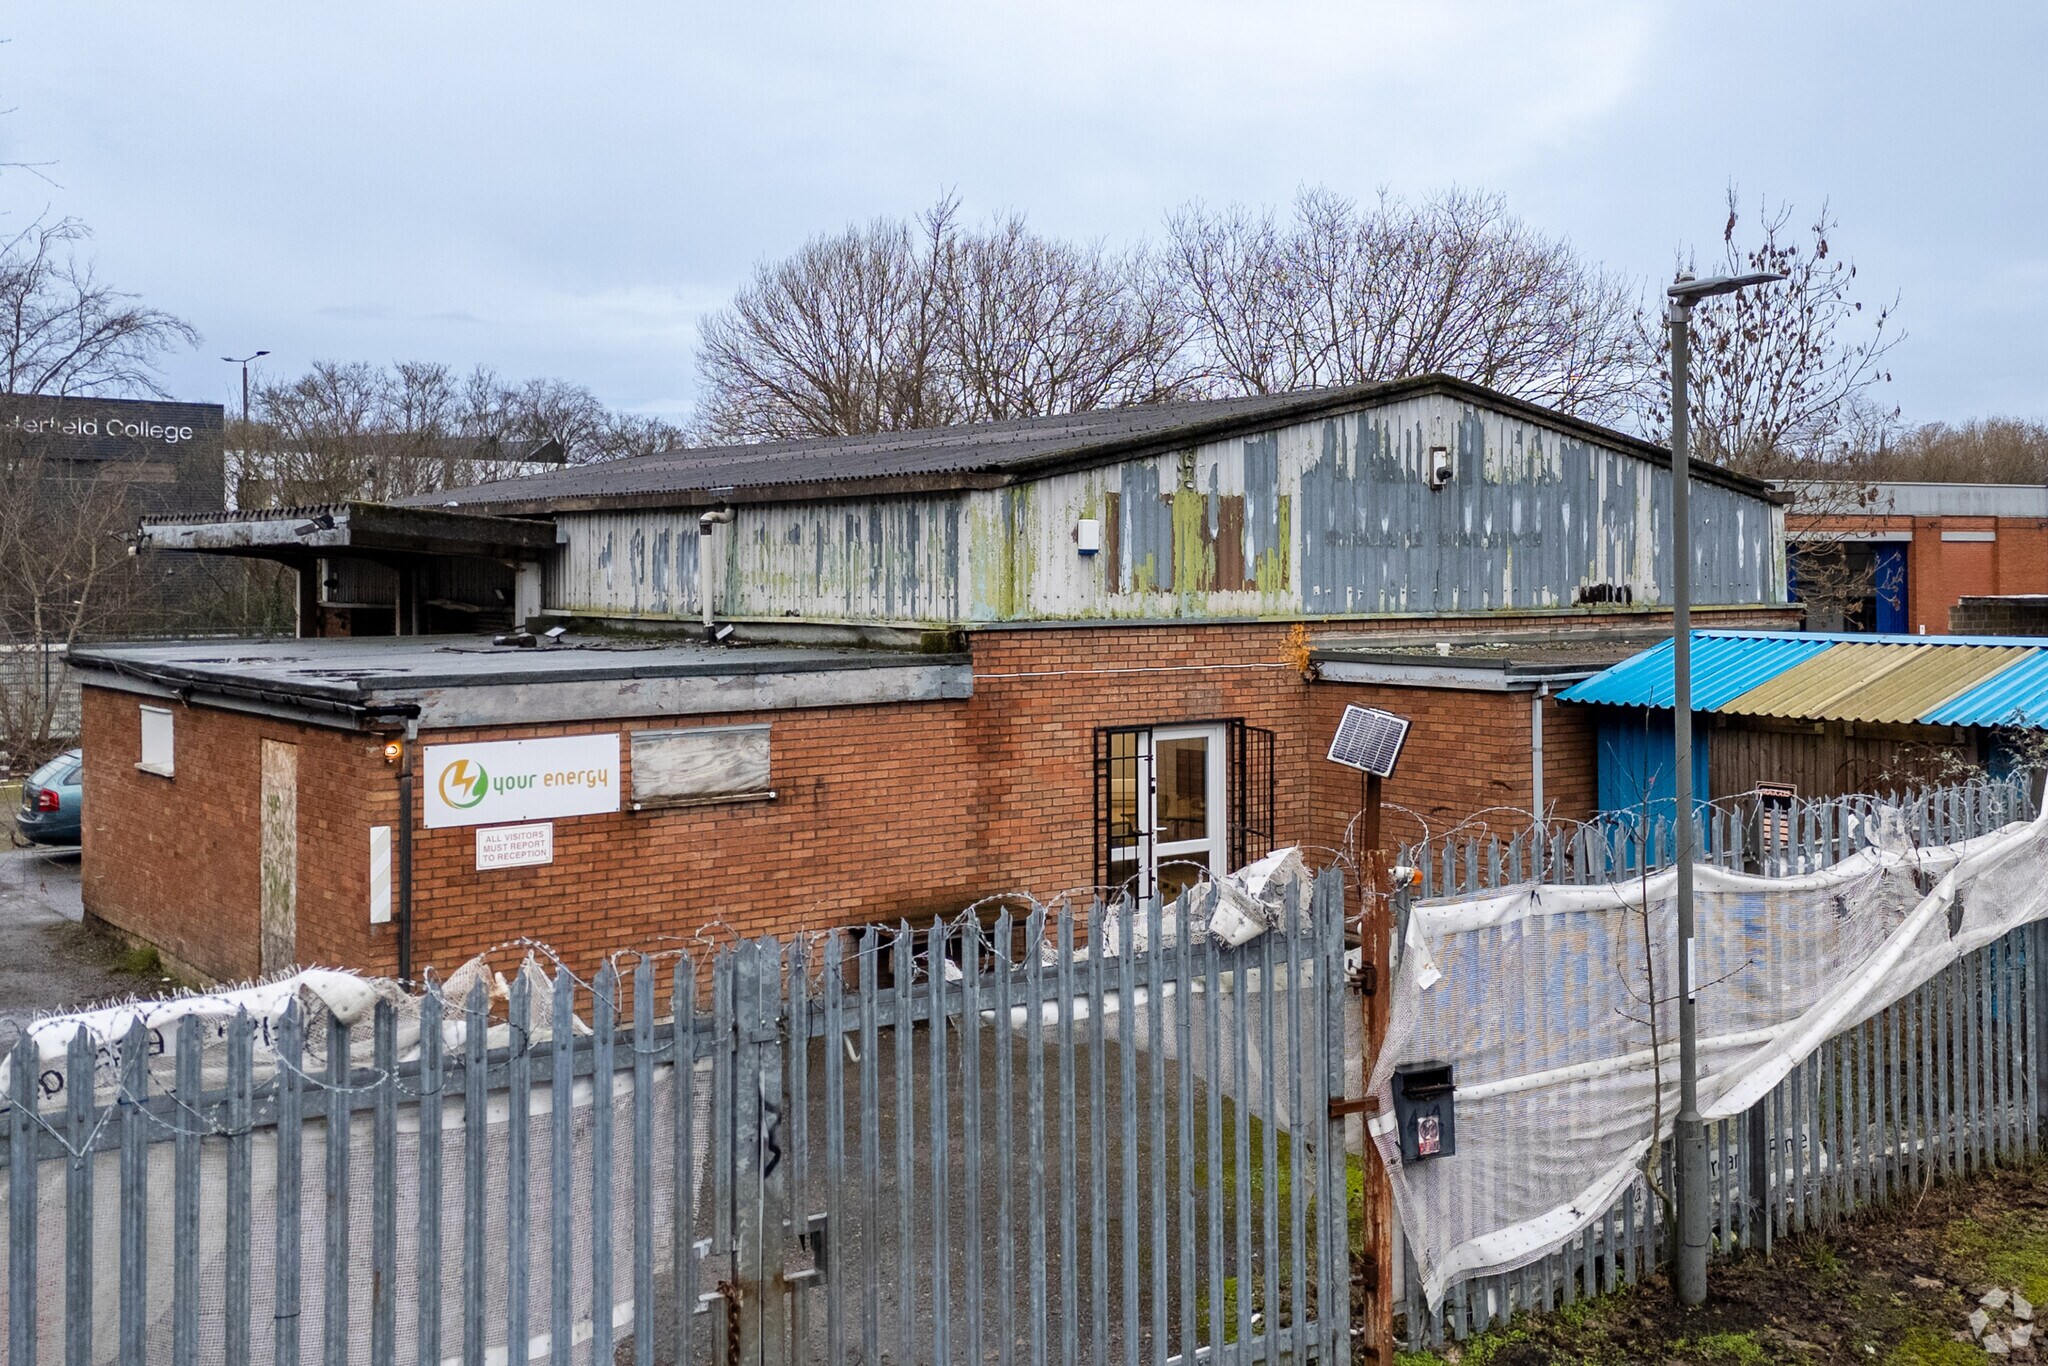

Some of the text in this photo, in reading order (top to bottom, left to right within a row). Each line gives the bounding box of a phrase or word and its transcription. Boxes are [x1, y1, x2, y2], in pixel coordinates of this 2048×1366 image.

[106, 418, 193, 443] College
[493, 768, 608, 795] your energy
[486, 831, 544, 843] ALL VISITORS
[483, 840, 546, 853] MUST REPORT
[483, 849, 547, 862] TO RECEPTION
